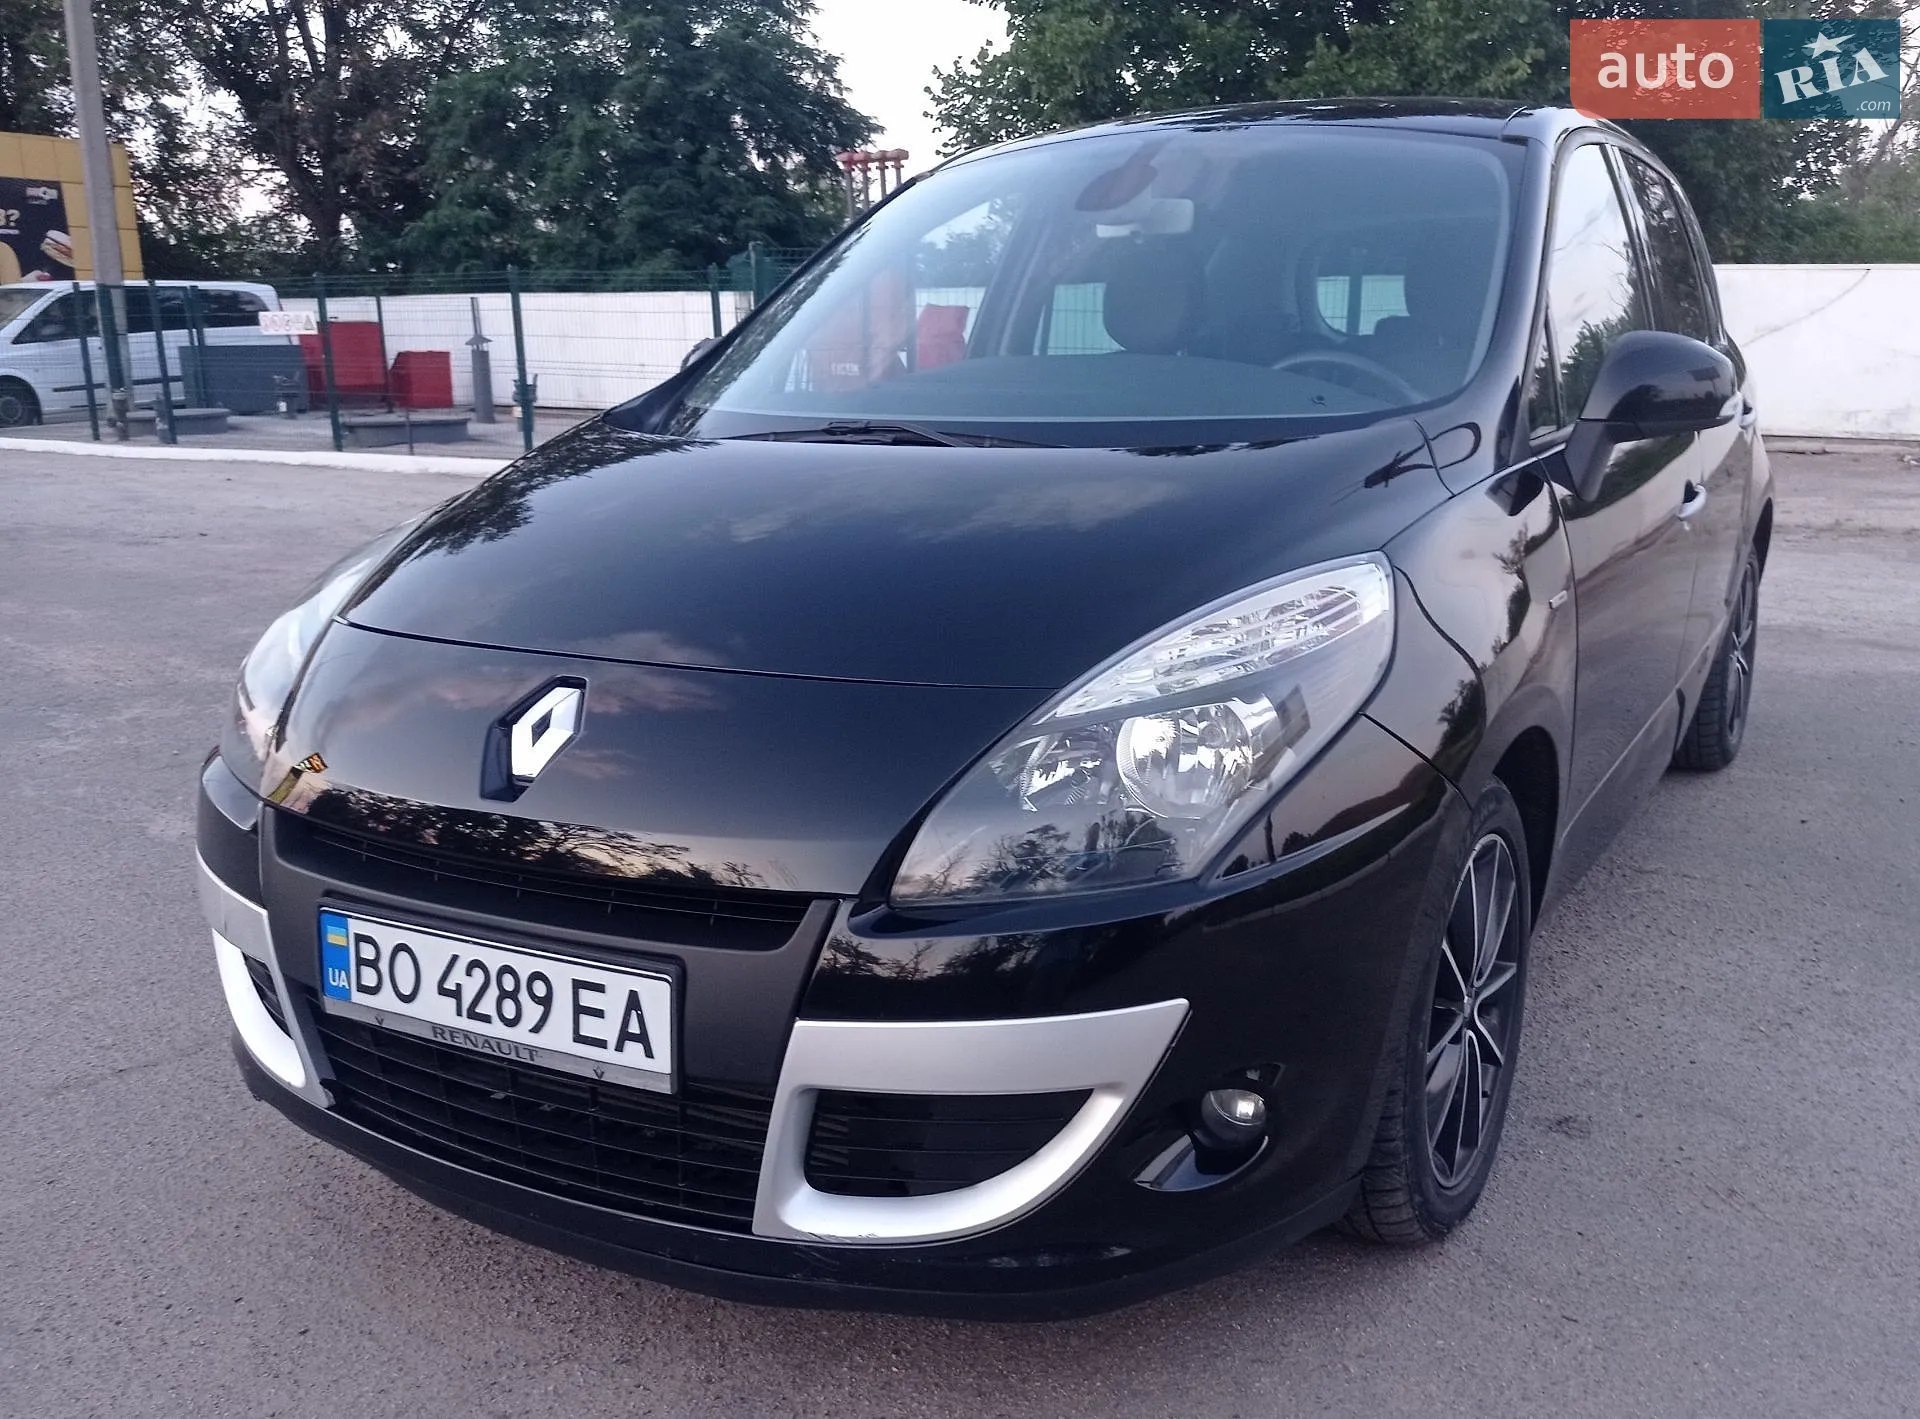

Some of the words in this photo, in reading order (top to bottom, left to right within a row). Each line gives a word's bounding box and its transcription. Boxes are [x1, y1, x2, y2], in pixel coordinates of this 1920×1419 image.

[328, 967, 349, 990] UA
[353, 932, 421, 1004] BO
[437, 953, 554, 1034] 4289
[571, 978, 655, 1060] EA
[431, 1025, 538, 1062] RENAULT
